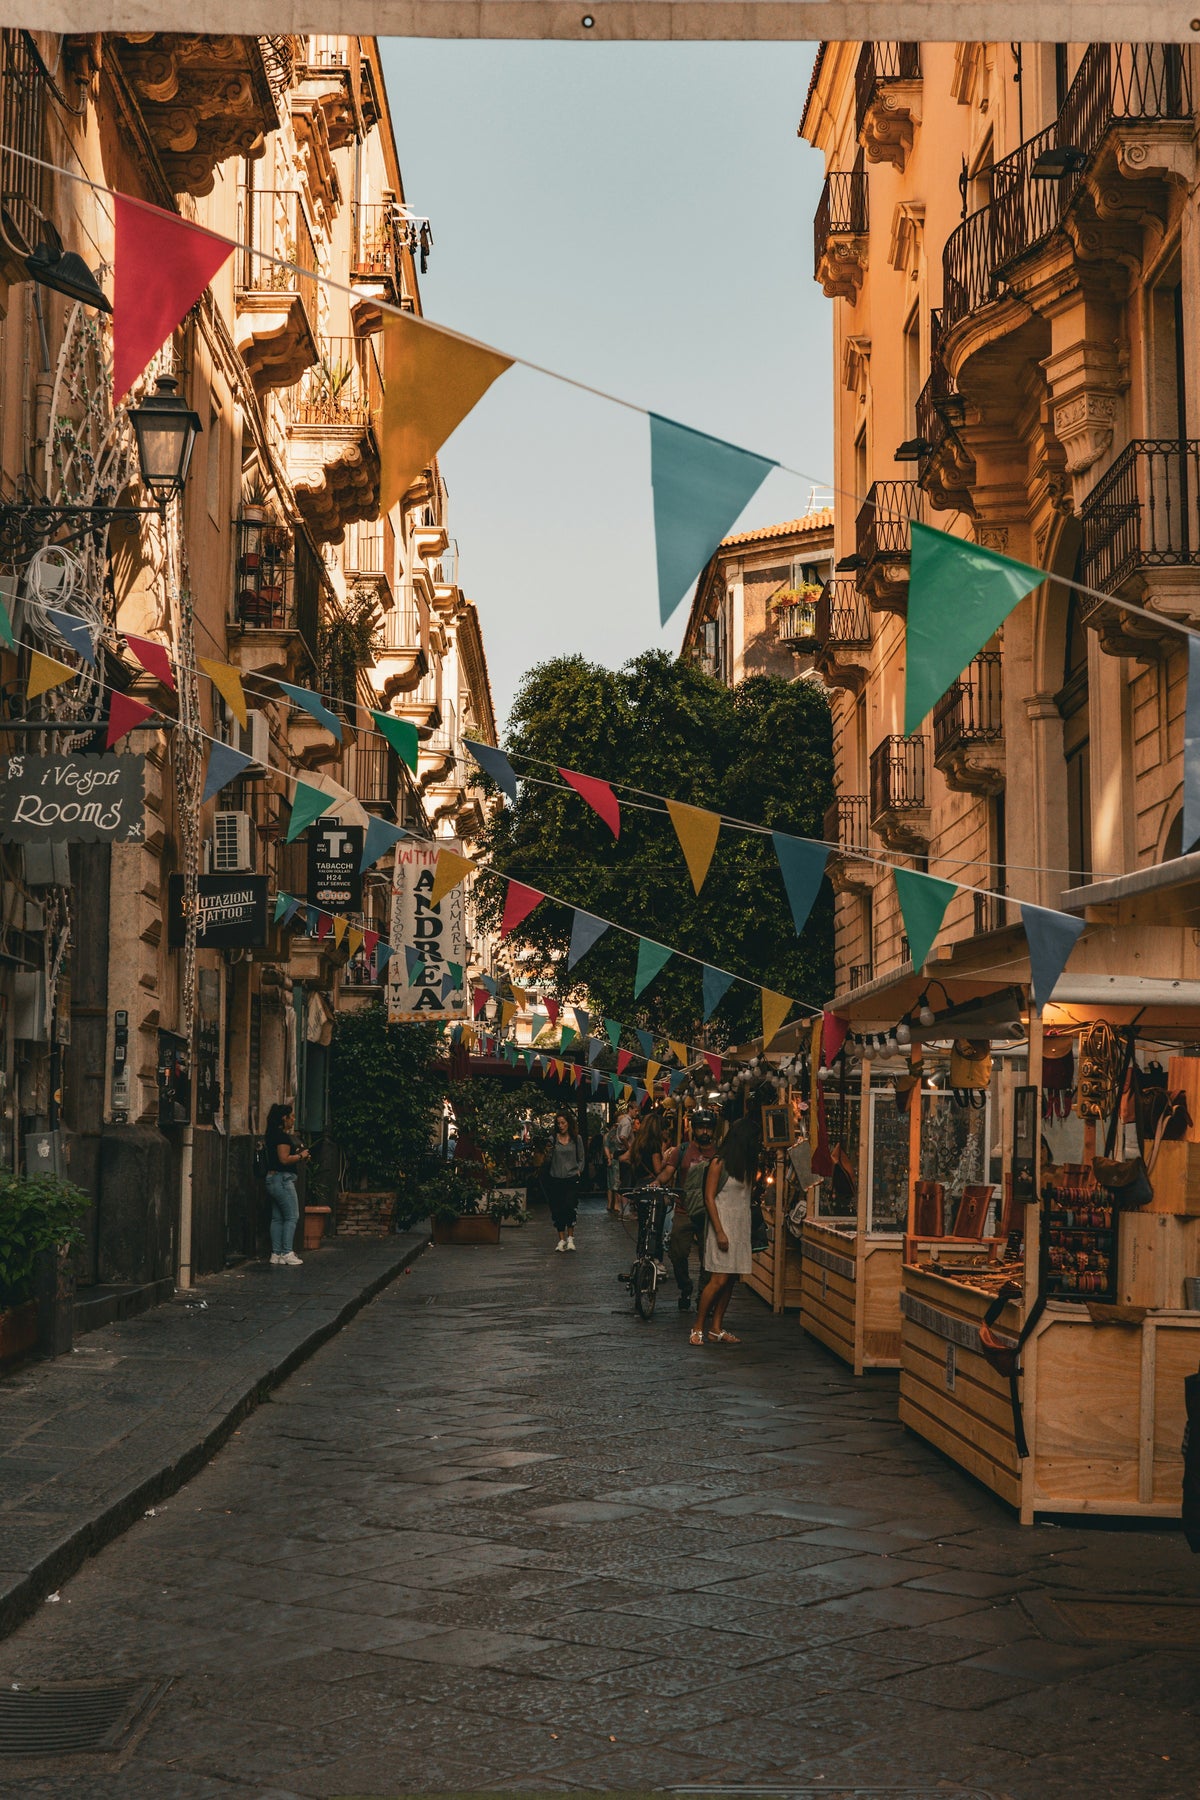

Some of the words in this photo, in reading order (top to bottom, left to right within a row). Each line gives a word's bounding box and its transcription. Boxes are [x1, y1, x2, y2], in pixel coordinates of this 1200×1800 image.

[11, 794, 123, 830] Rooms
[323, 831, 347, 858] T
[317, 891, 351, 900] LOTTO
[196, 906, 243, 936] TATTOO
[412, 870, 444, 1010] ANDREA
